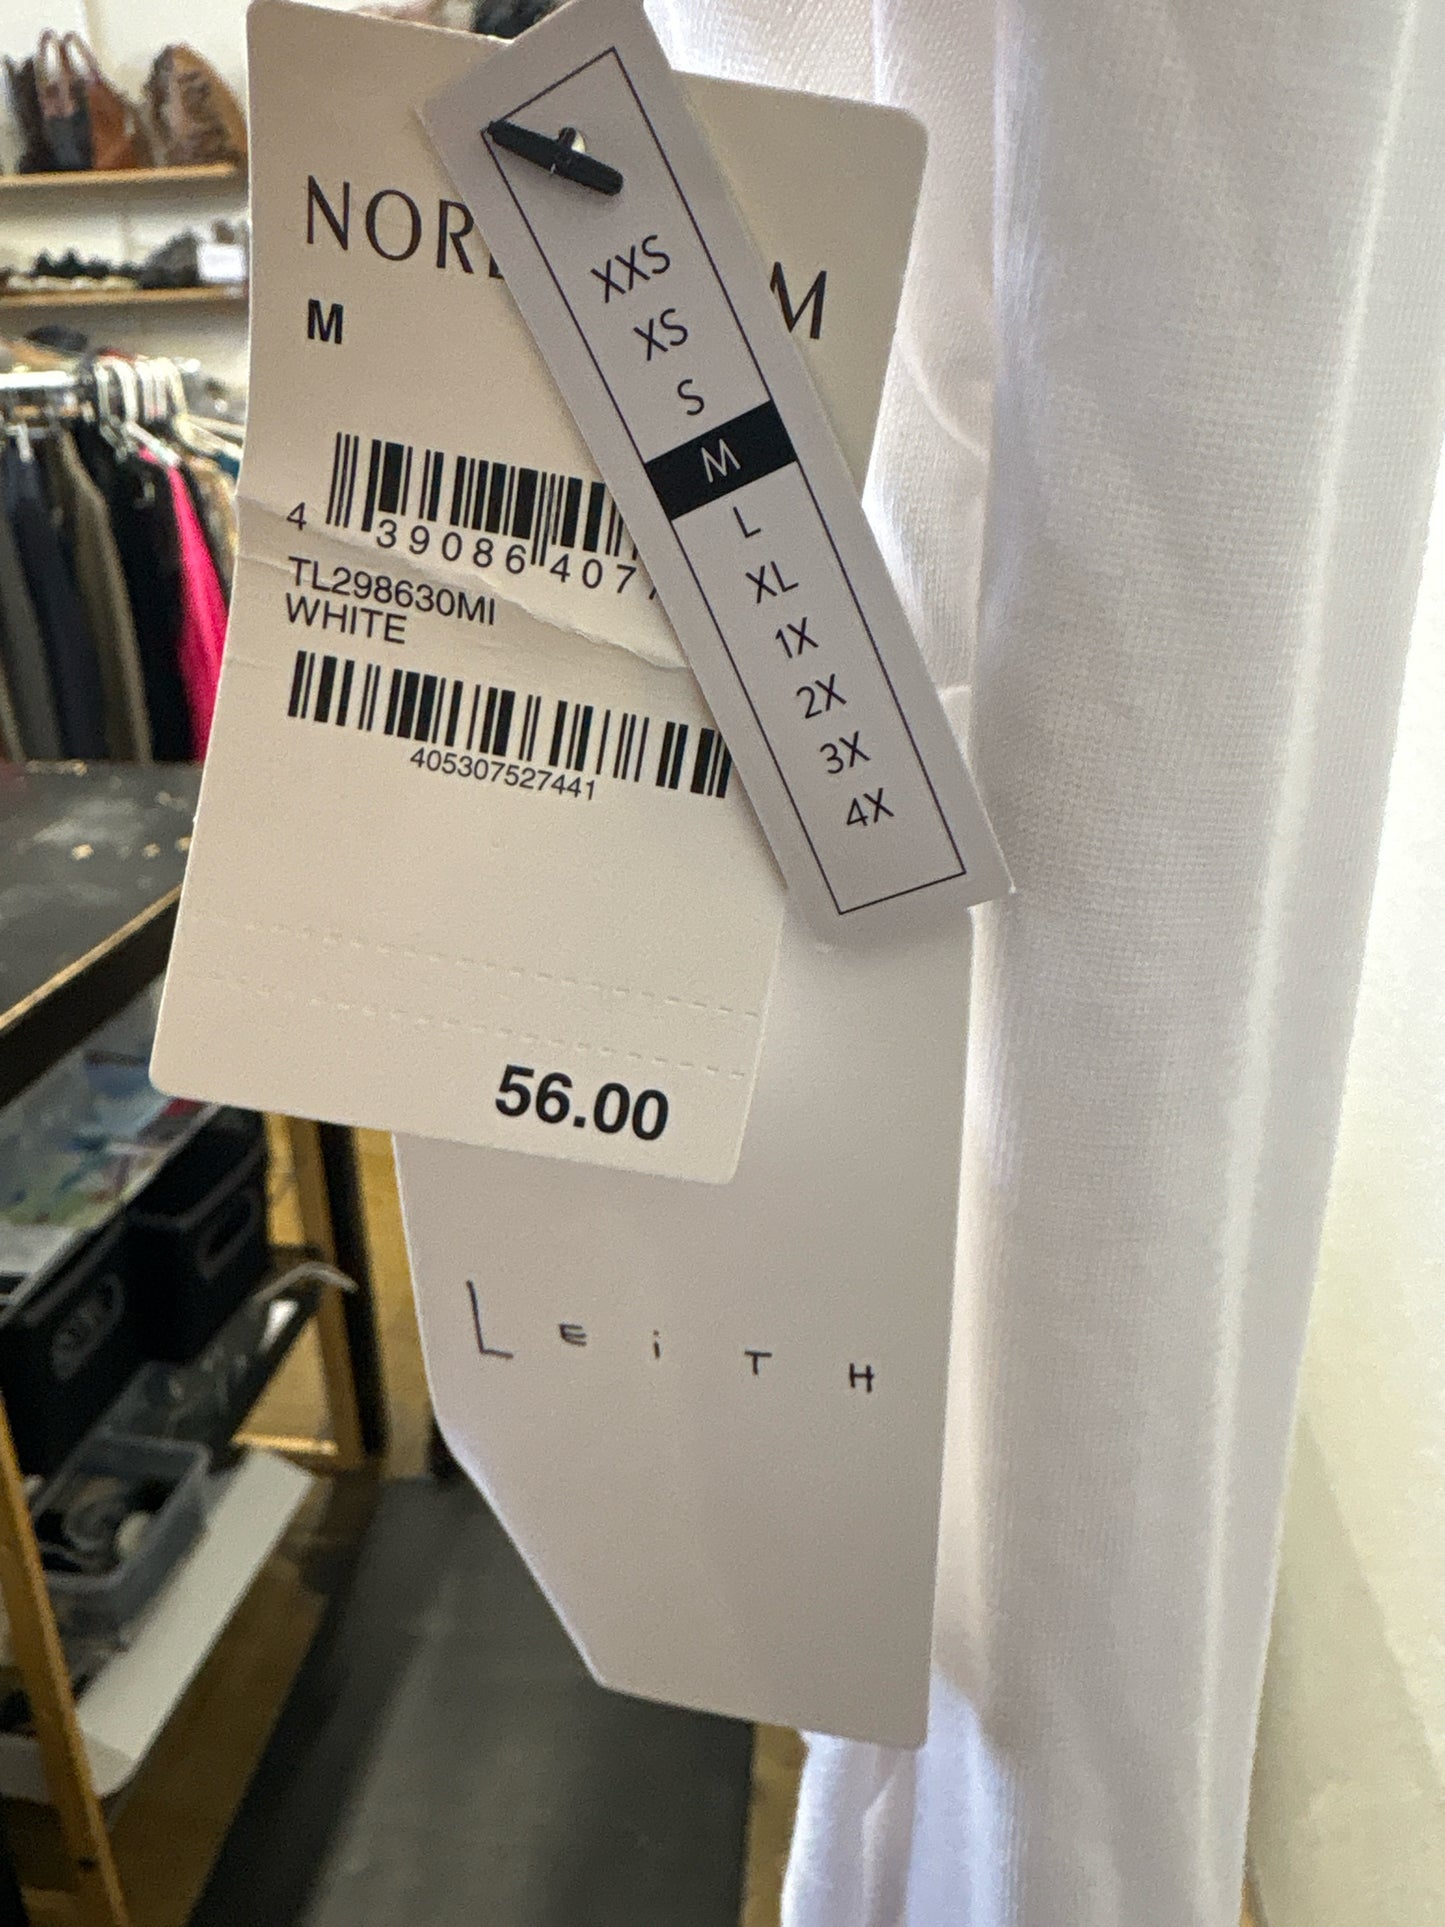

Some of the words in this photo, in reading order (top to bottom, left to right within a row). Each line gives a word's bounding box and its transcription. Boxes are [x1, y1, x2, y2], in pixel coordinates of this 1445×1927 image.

[590, 234, 671, 304] XXS
[307, 298, 344, 345] M
[633, 308, 688, 361] XS
[677, 379, 704, 416] S
[701, 438, 741, 484] M
[286, 502, 307, 531] 4
[733, 506, 762, 538] L
[287, 556, 496, 626] TL298630MI
[745, 560, 799, 604] XL
[286, 592, 408, 645] WHITE
[775, 616, 819, 659] 1X
[796, 673, 847, 719] 2X
[410, 747, 596, 801] 405307527441
[819, 731, 871, 774] 3X
[846, 787, 894, 827] 4X
[495, 1064, 670, 1141] 56.00
